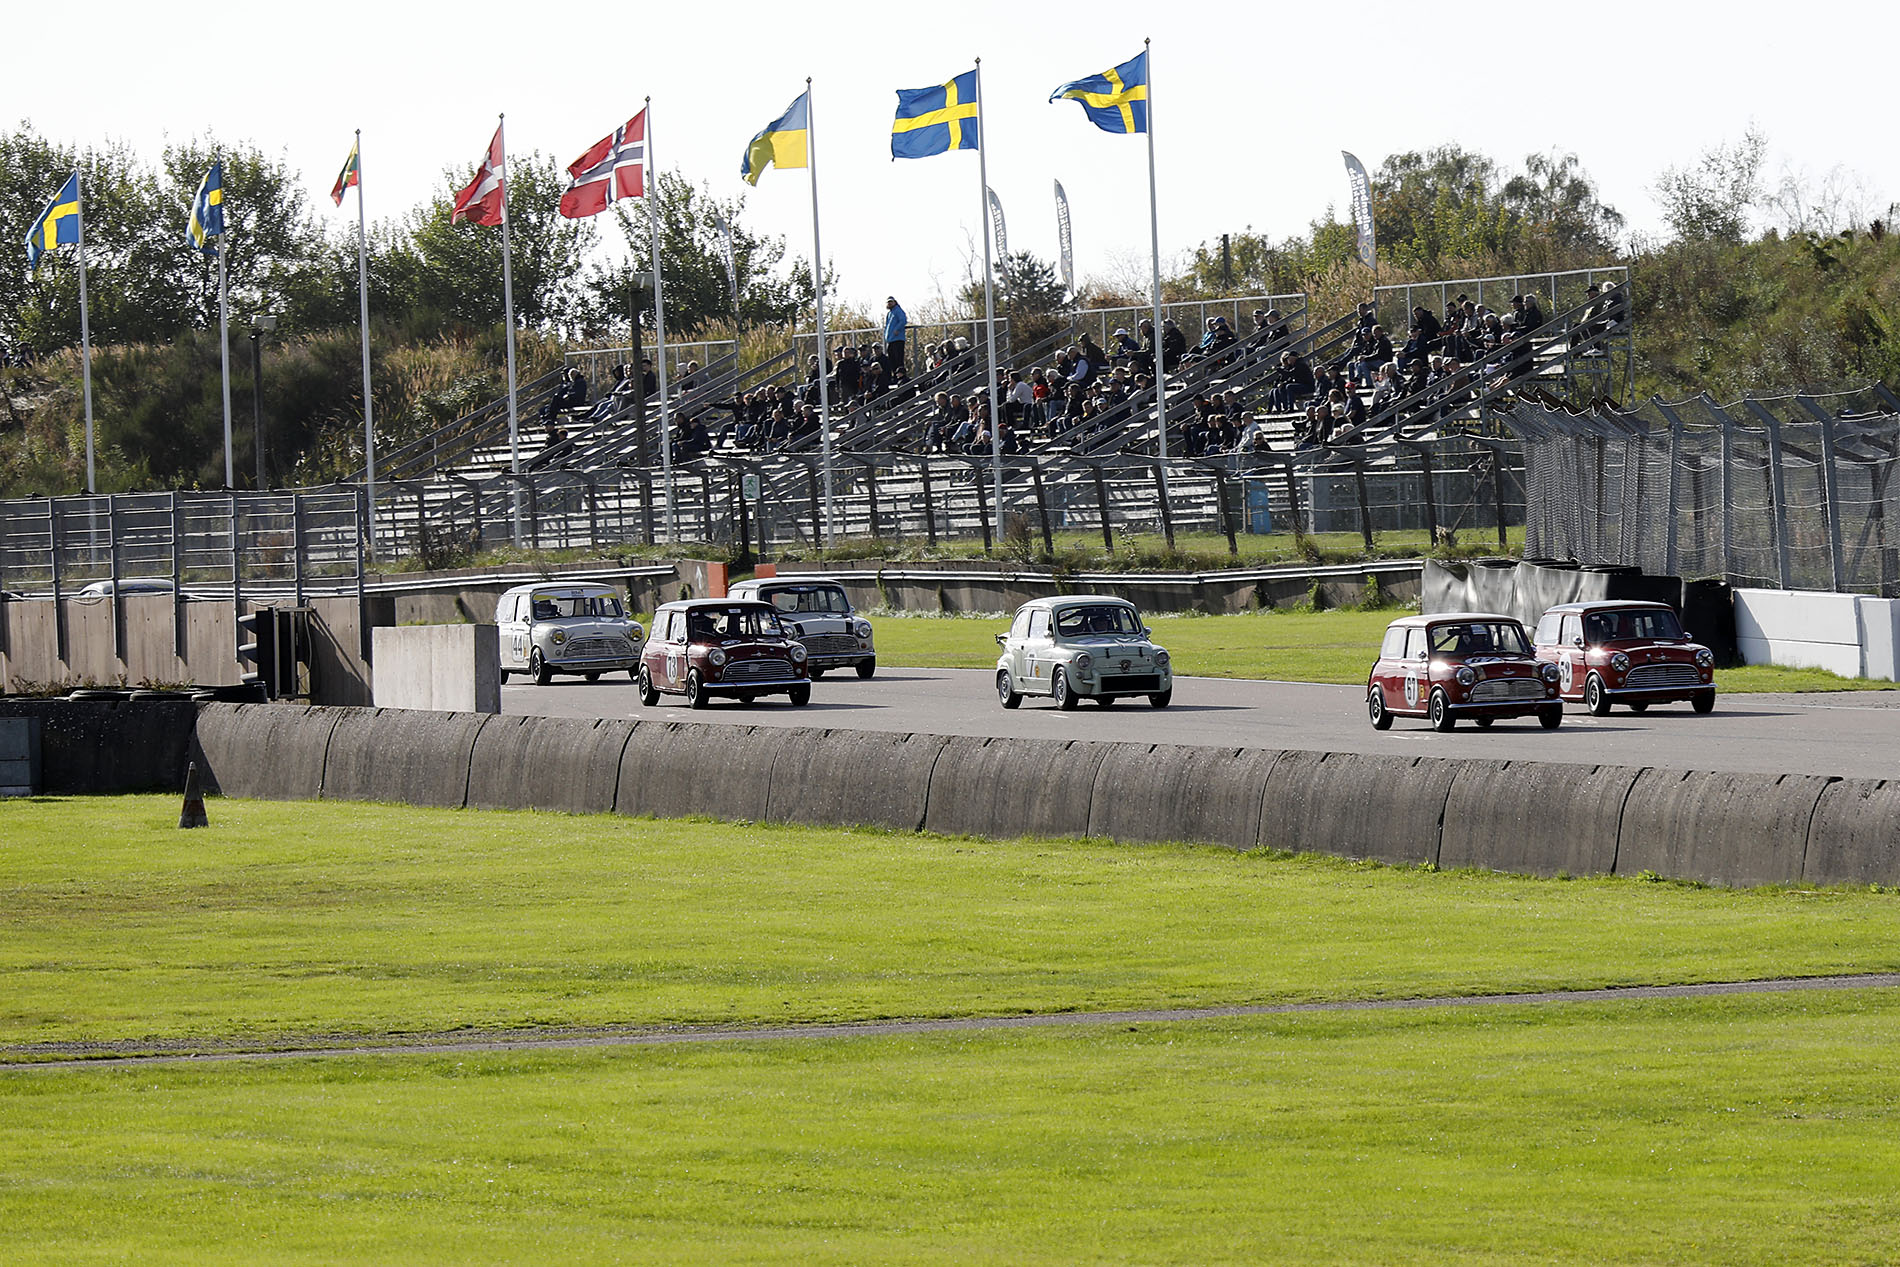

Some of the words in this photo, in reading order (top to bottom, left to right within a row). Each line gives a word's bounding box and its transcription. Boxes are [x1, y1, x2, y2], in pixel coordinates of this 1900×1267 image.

[512, 634, 523, 656] 44
[667, 655, 678, 679] 73
[1560, 661, 1570, 683] 52
[1406, 677, 1416, 701] 67
